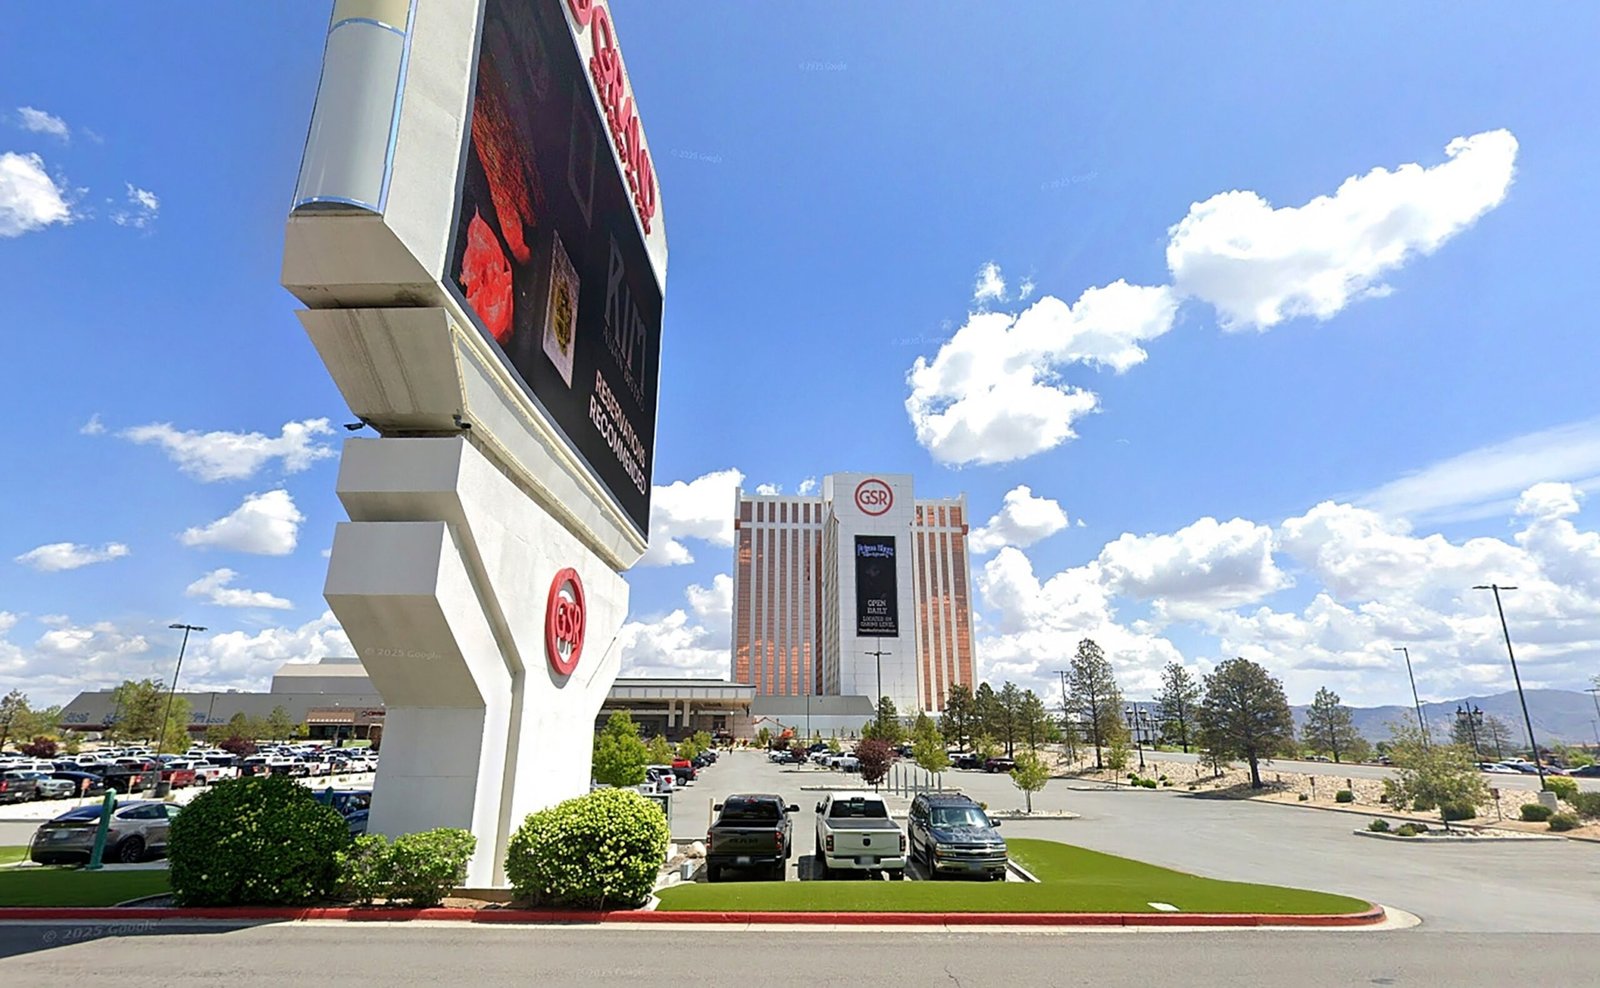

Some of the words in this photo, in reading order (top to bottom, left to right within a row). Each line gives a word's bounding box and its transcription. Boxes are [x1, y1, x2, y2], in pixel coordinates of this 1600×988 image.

[595, 369, 646, 466] RESERVATIONS
[589, 395, 647, 496] RECOMMENDED
[859, 490, 888, 506] GSR
[867, 599, 886, 607] OPEN
[867, 607, 888, 615] DAILY
[556, 597, 582, 647] GSR
